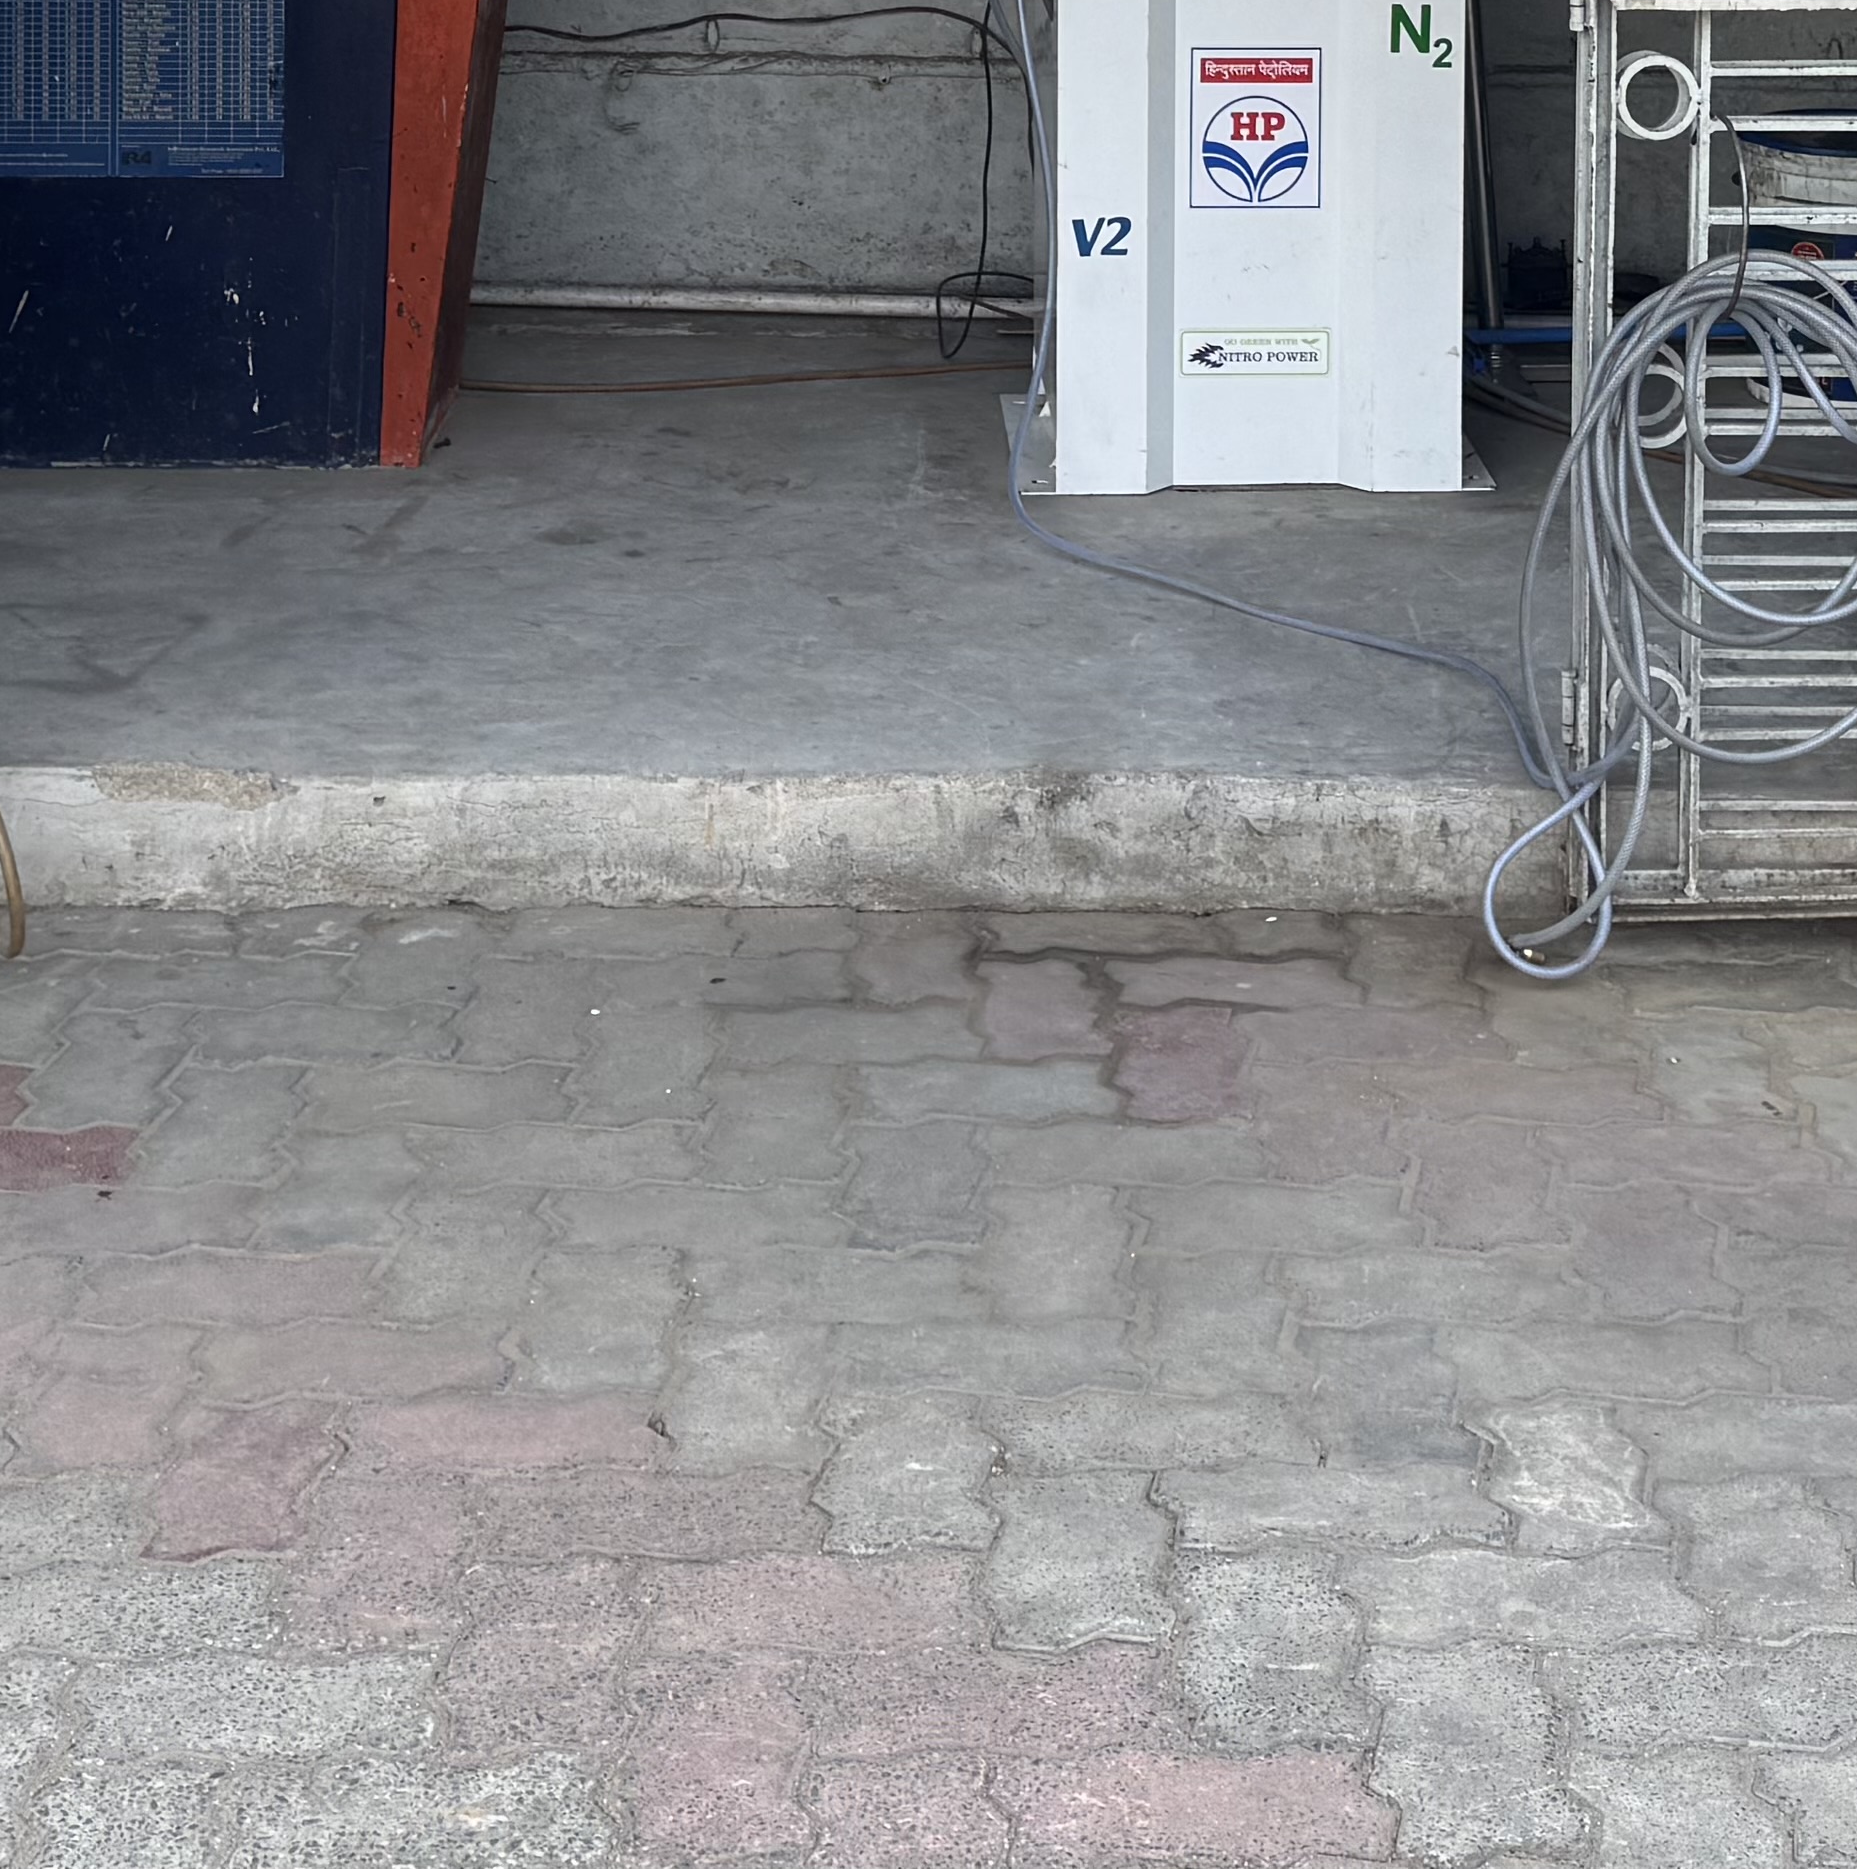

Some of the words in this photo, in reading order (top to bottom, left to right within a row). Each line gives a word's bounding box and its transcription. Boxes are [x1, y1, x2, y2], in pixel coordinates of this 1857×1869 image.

[1230, 112, 1285, 140] HP
[1072, 217, 1132, 258] V2
[1218, 351, 1263, 362] NITRO
[1267, 351, 1319, 362] POWER
